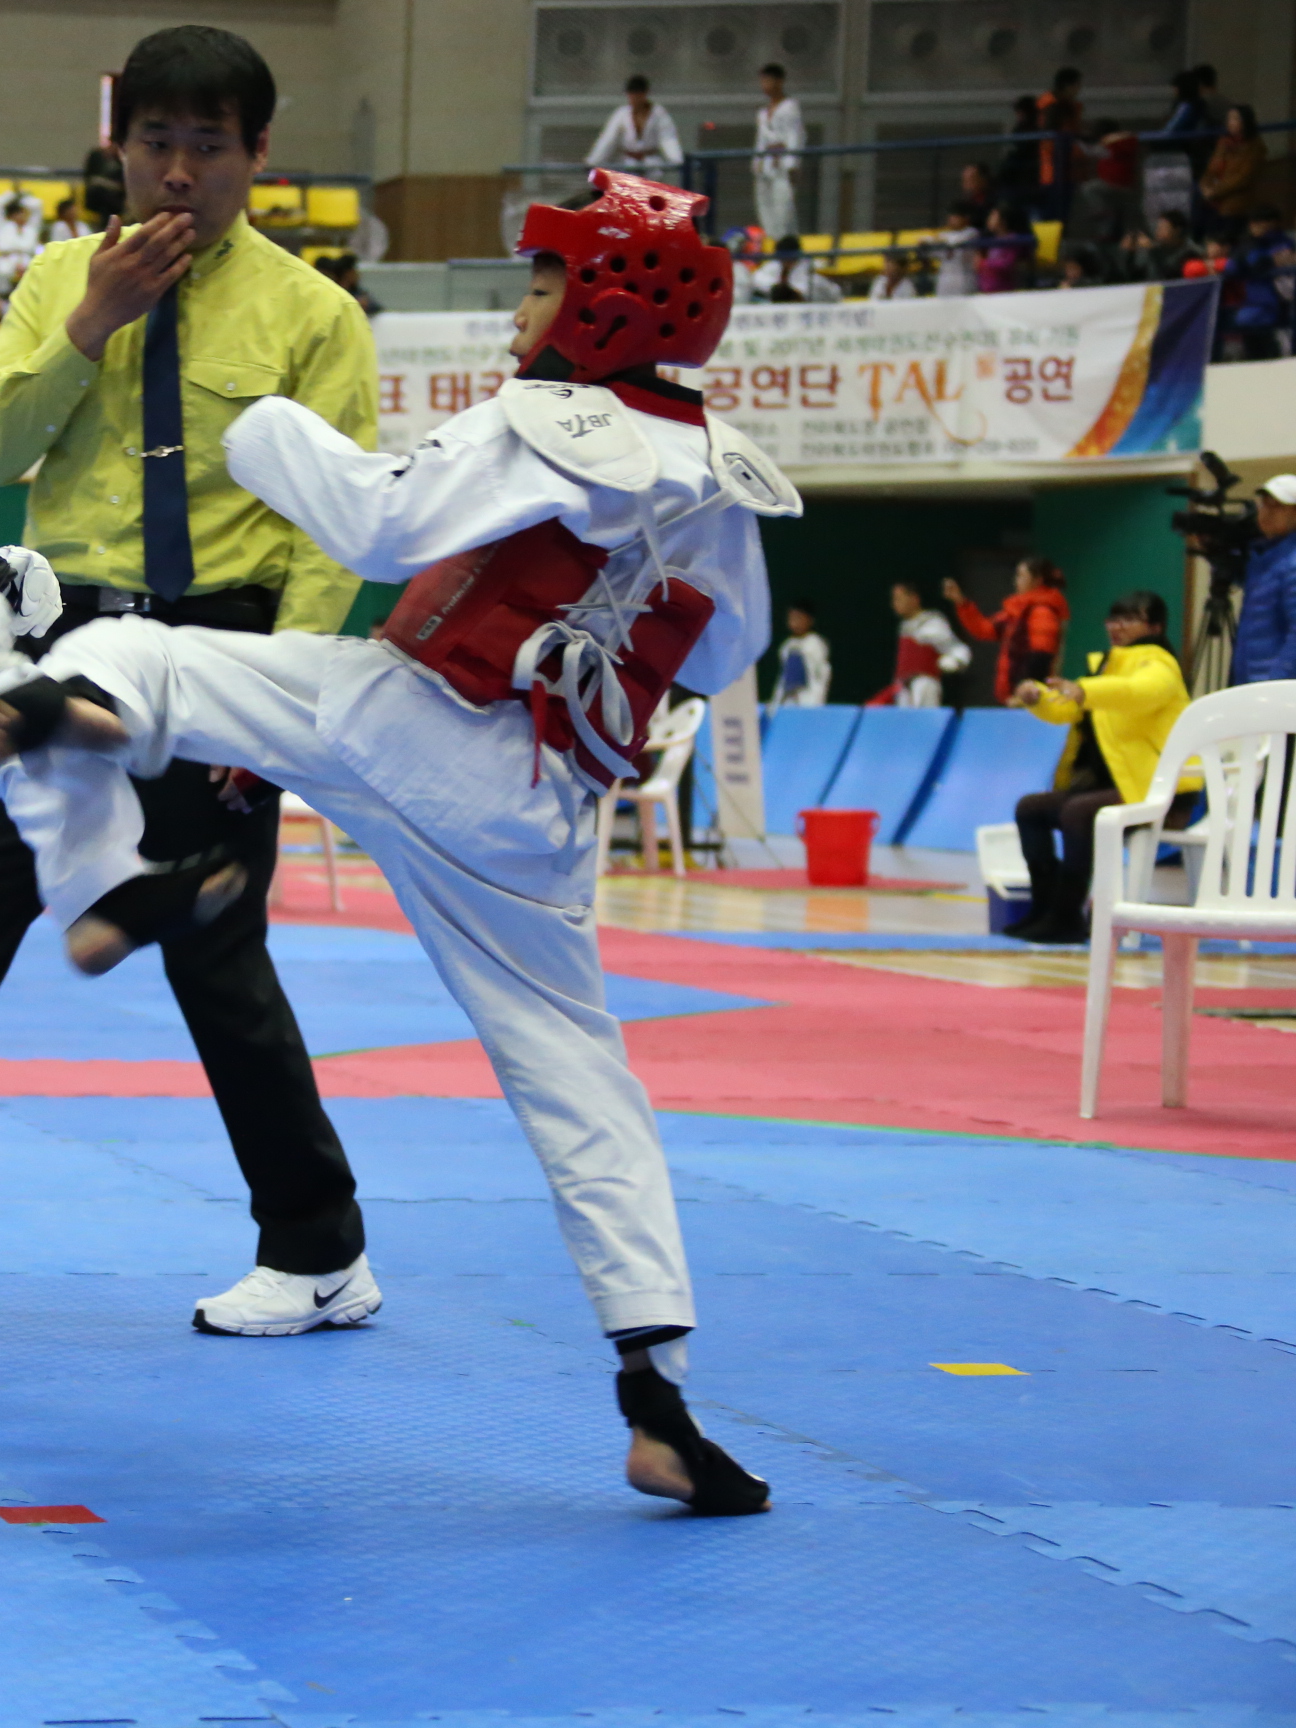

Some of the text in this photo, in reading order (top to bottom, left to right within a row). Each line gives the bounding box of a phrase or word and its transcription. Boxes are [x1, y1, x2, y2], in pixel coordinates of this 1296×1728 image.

[703, 364, 842, 411] 공연단
[1002, 355, 1075, 405] 공연
[555, 412, 613, 439] JBTA
